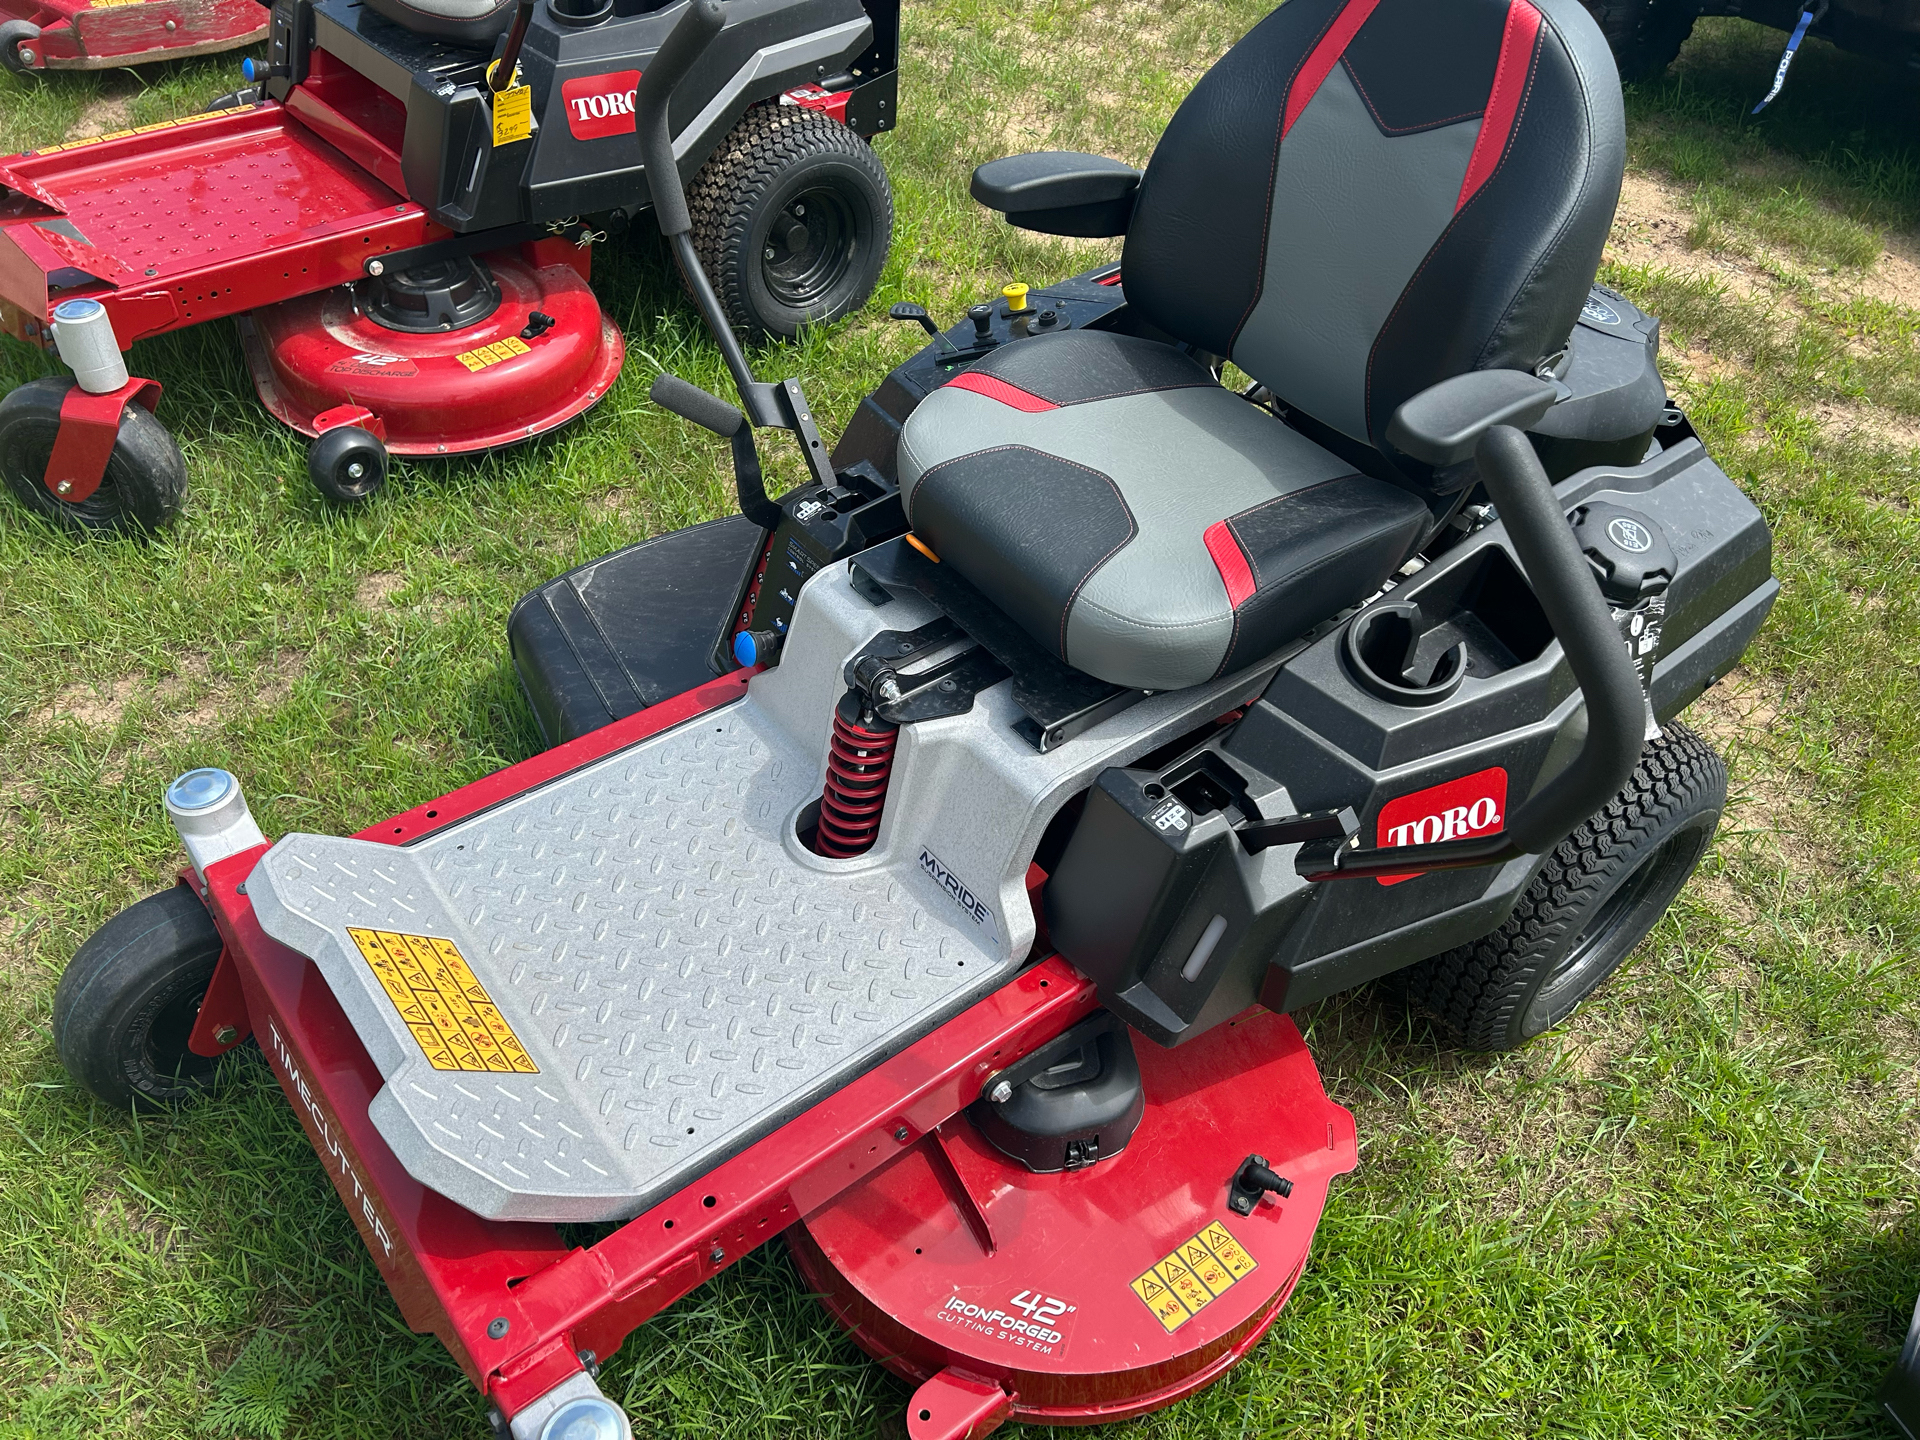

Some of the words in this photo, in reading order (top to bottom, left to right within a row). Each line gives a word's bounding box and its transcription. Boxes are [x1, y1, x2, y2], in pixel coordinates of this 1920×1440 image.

[1764, 50, 1794, 102] POLARIS
[330, 365, 352, 373] TOP
[352, 367, 416, 377] DISCHARGE
[806, 556, 820, 570] SPEE
[1388, 797, 1497, 847] TORO
[920, 863, 956, 901] SUSPENSION
[957, 900, 980, 926] SYSTEM
[270, 1023, 391, 1258] TIMECUTTER
[945, 1296, 1062, 1344] IRONFORGED
[1010, 1290, 1077, 1326] 42"
[937, 1311, 994, 1336] CUTTING
[997, 1331, 1053, 1355] SYSTEM
